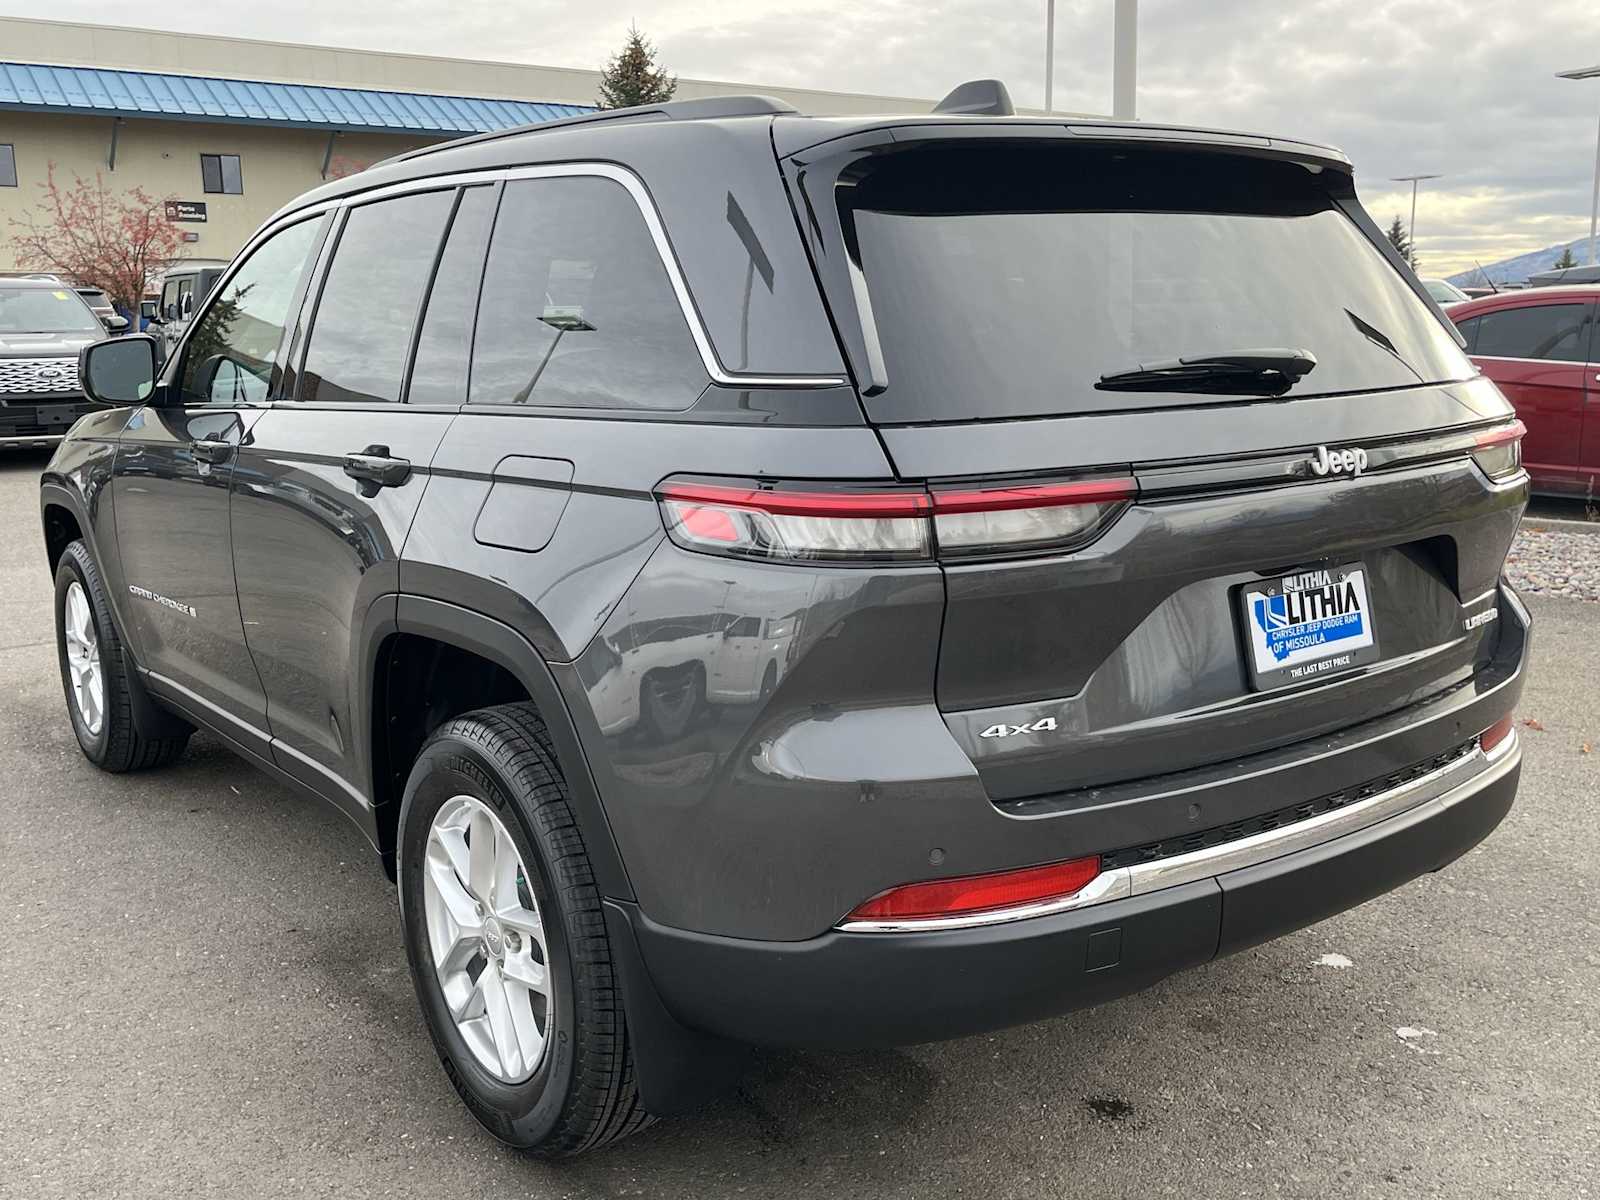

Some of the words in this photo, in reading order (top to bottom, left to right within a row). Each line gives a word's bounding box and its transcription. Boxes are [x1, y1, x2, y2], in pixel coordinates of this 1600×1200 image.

[1312, 446, 1368, 477] Jeep
[1292, 570, 1331, 592] LITHIA
[1287, 582, 1361, 625] LITHIA
[1271, 623, 1306, 641] CHRYSLER
[1306, 621, 1322, 635] JEEP
[1323, 617, 1344, 630] DODGE
[1344, 614, 1359, 625] RAM
[1273, 640, 1284, 654] OF
[1285, 633, 1326, 651] MISSOULA
[1290, 667, 1303, 678] THE
[1302, 663, 1318, 675] LAST
[1318, 659, 1333, 671] BEST
[1333, 655, 1350, 668] PRICE
